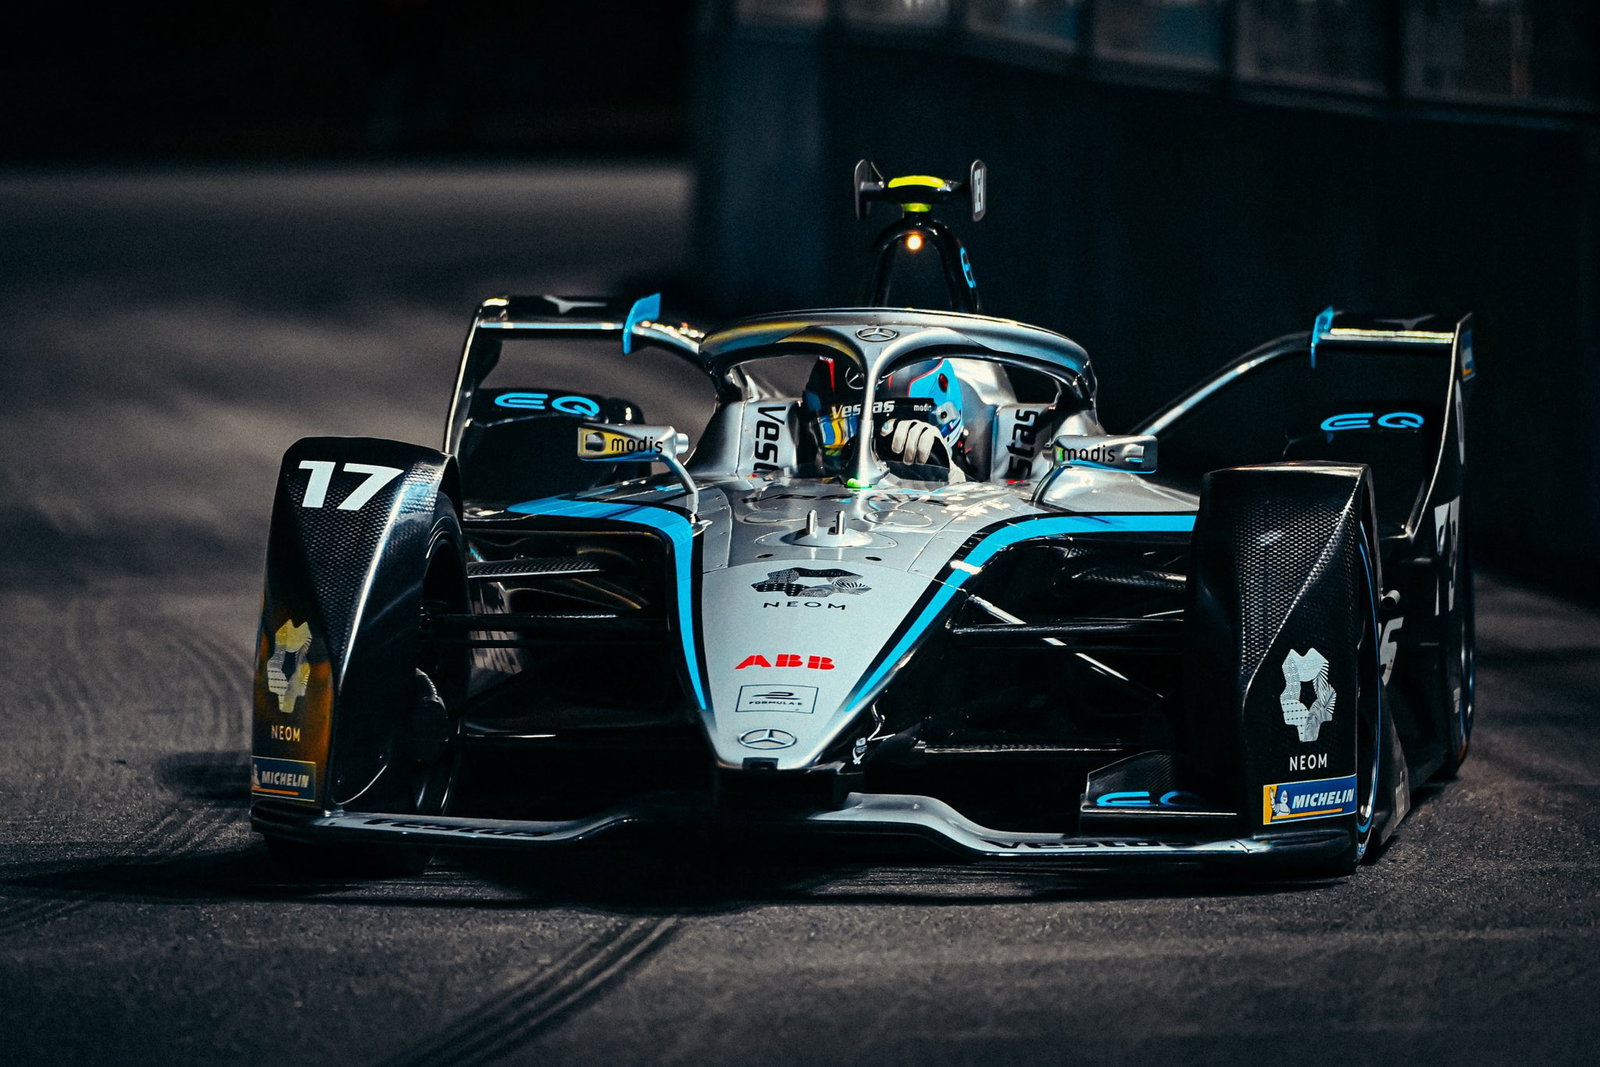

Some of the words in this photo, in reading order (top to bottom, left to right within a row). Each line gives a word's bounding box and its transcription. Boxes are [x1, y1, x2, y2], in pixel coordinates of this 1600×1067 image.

[831, 399, 895, 420] Vesas
[610, 434, 664, 455] modis
[1061, 445, 1116, 463] modis
[297, 460, 405, 512] 17
[763, 602, 846, 610] NEOM
[734, 653, 836, 670] ABB
[270, 724, 301, 743] NEOM
[1289, 754, 1329, 772] NEOM
[260, 769, 310, 789] MICHELIN
[1290, 787, 1356, 809] MICHELIN
